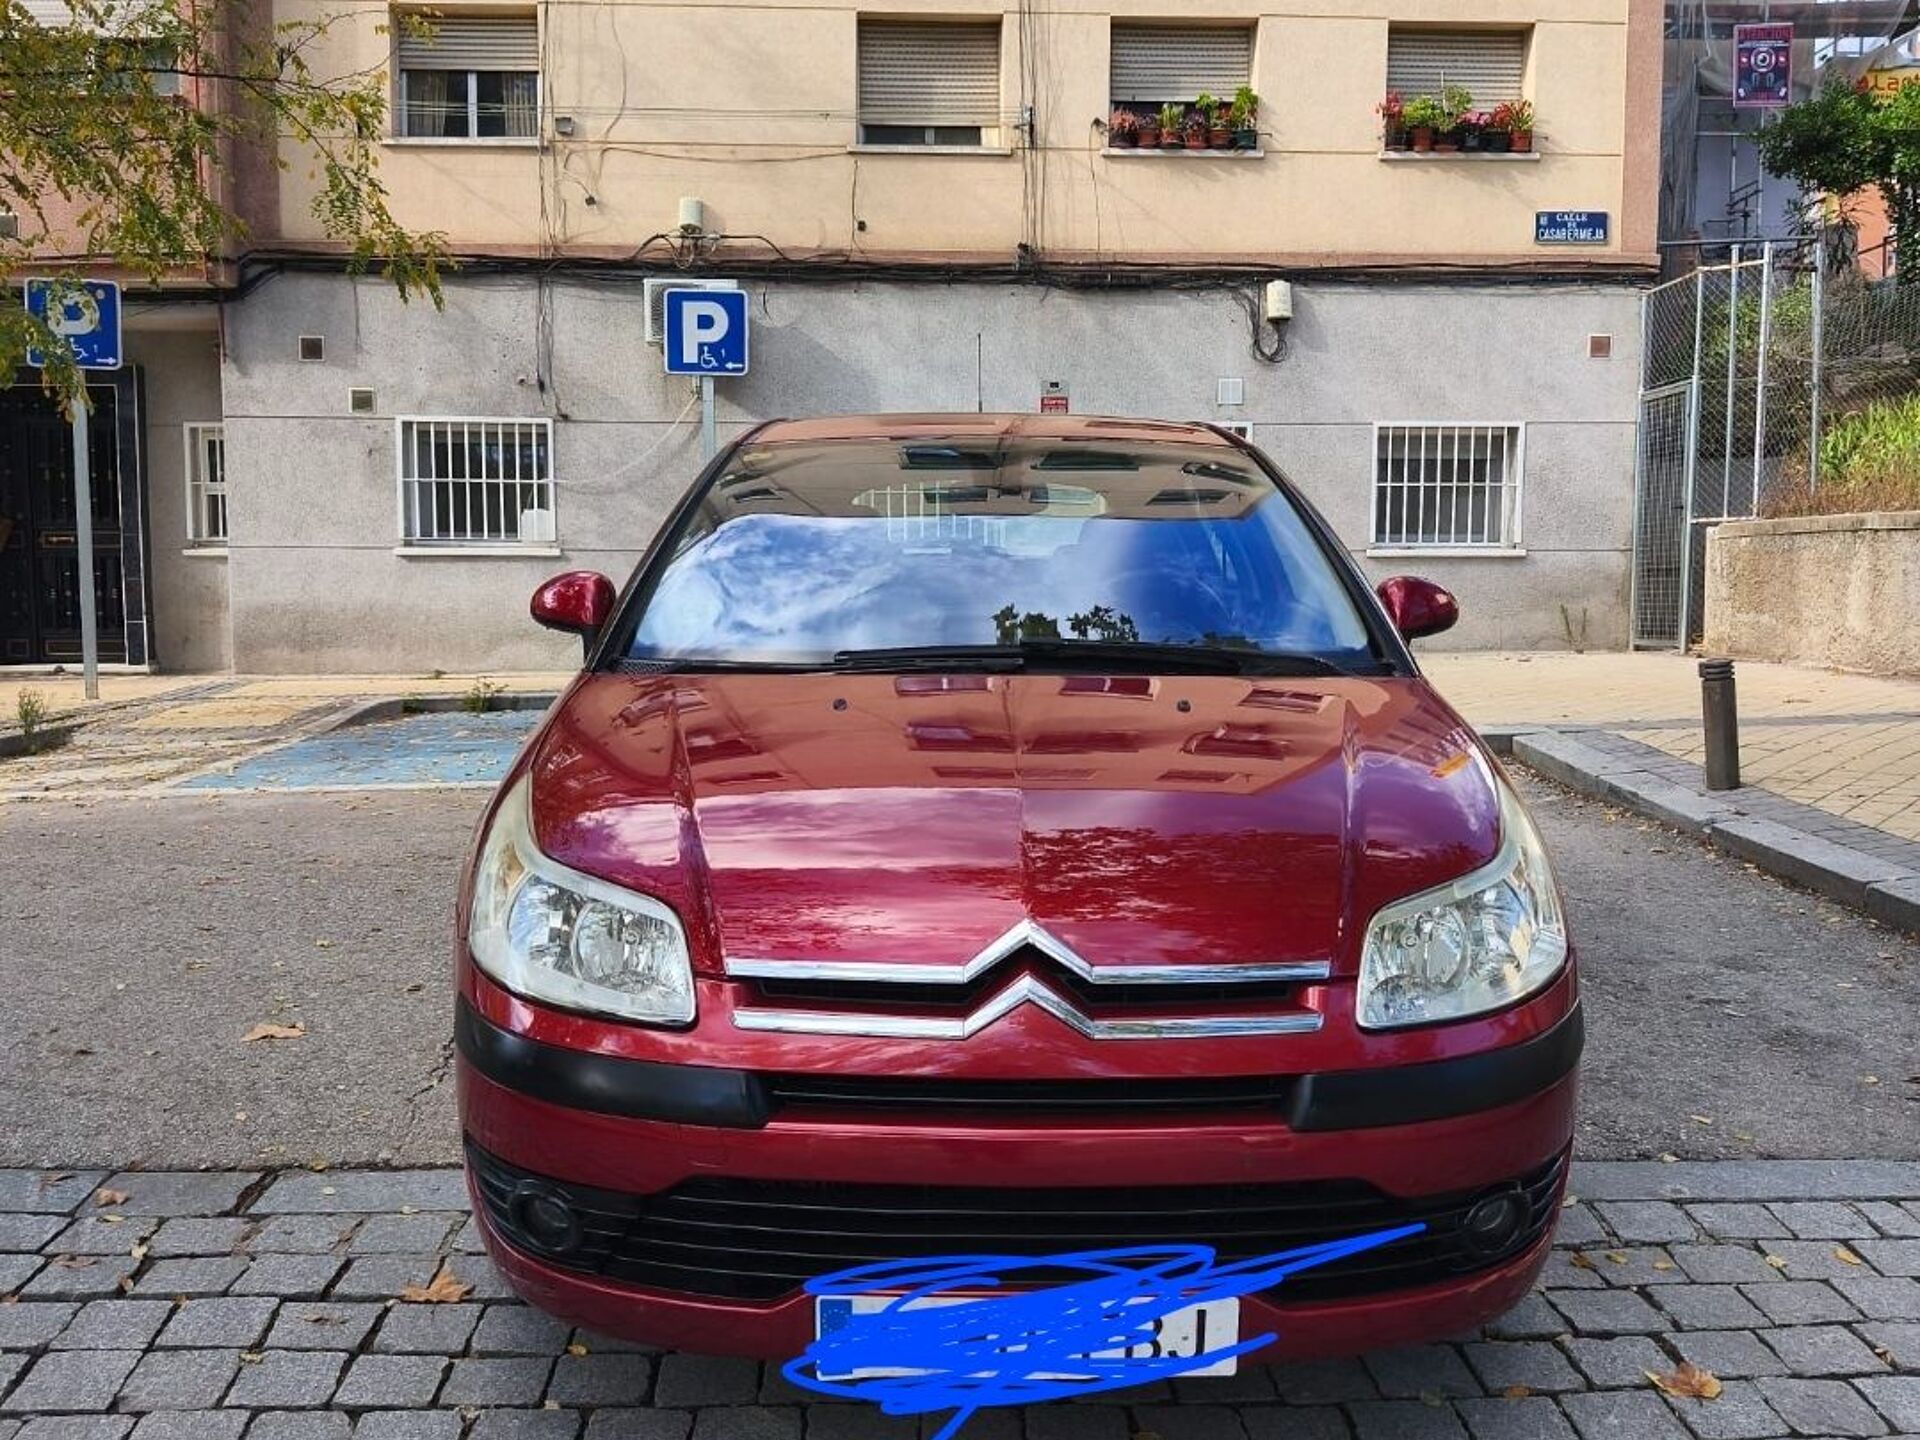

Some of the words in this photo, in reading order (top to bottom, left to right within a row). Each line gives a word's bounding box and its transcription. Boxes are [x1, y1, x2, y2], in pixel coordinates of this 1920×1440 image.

[1556, 213, 1588, 222] CALLE
[1538, 228, 1604, 241] CASABERMEJA
[682, 301, 729, 364] P
